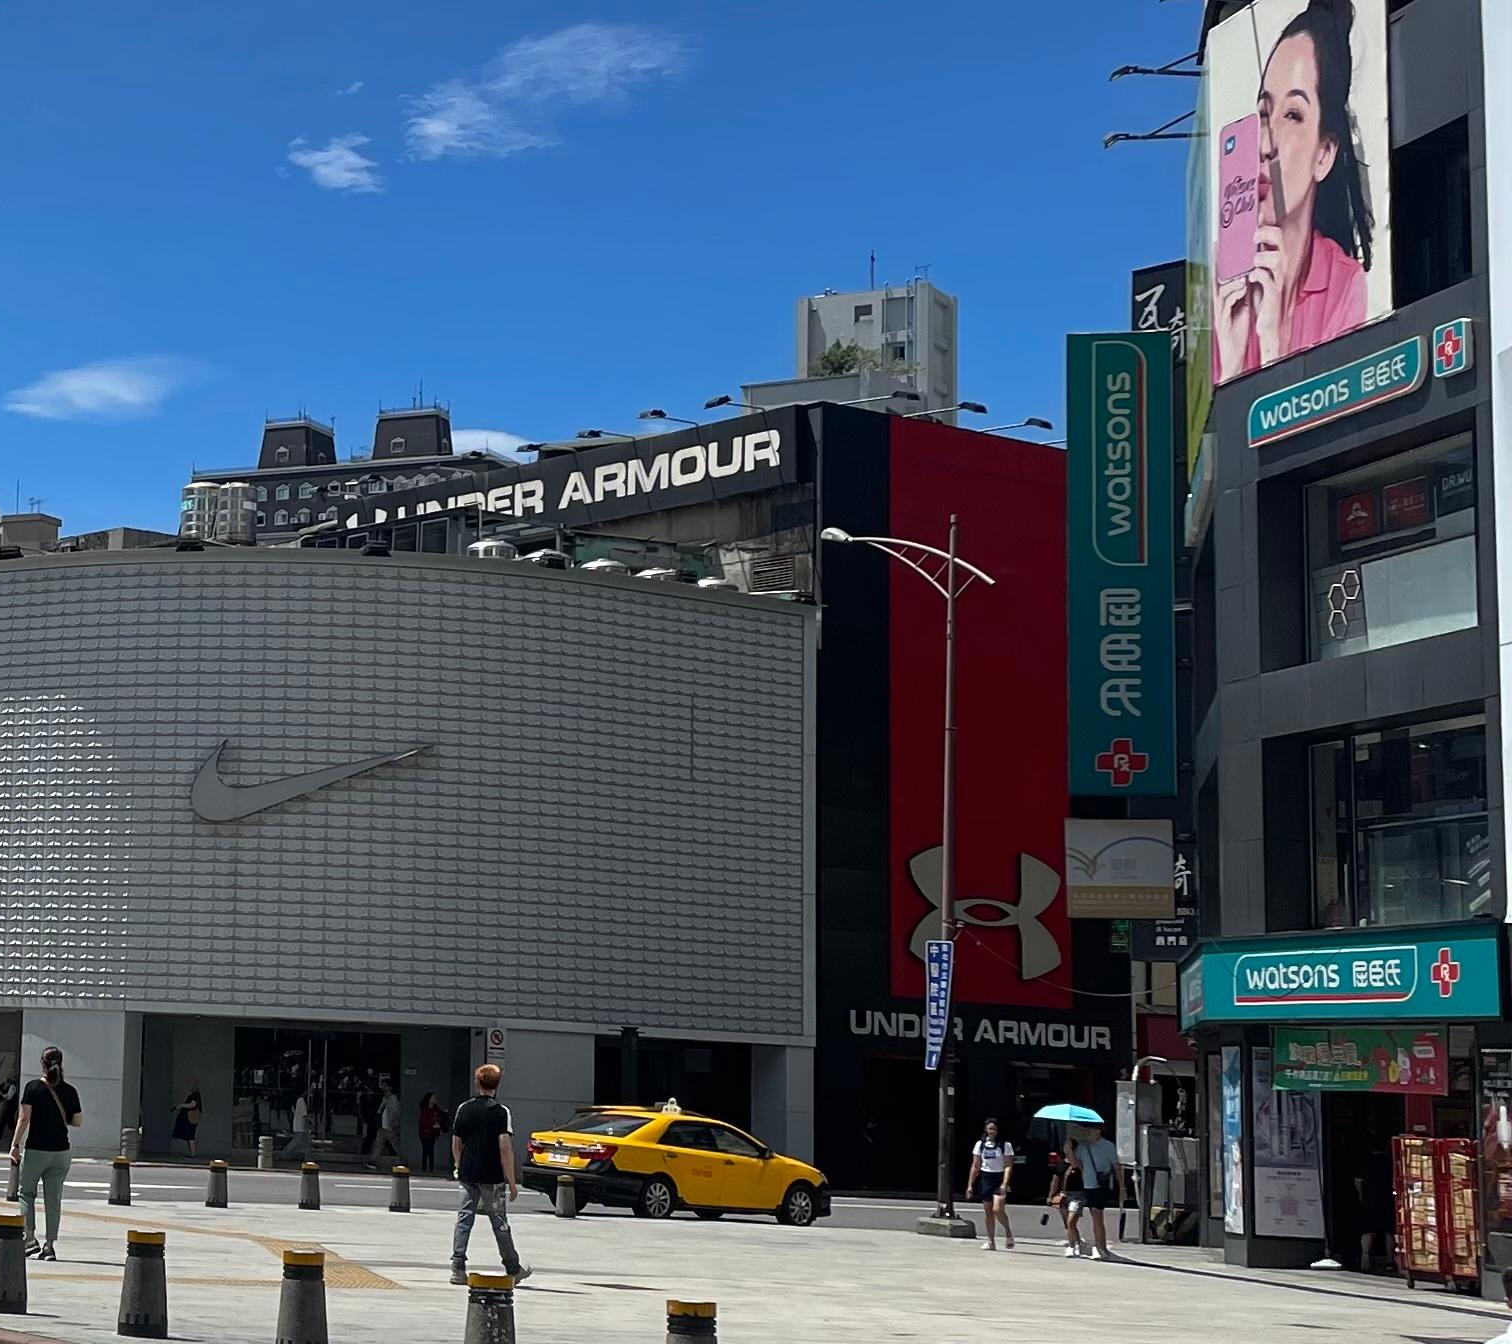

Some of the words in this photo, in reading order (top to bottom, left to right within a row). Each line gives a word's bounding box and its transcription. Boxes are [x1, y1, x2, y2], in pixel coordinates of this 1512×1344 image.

[1260, 378, 1350, 430] watsons
[1360, 353, 1406, 394] 屈臣氏
[558, 428, 781, 511] ARMOUR
[1106, 371, 1132, 537] watsons
[1099, 586, 1142, 718] 屈臣氏
[1245, 962, 1339, 990] watsons
[1352, 959, 1401, 987] 屈臣氏
[849, 1009, 963, 1042] UNDR
[974, 1018, 1112, 1050] ARMOUR
